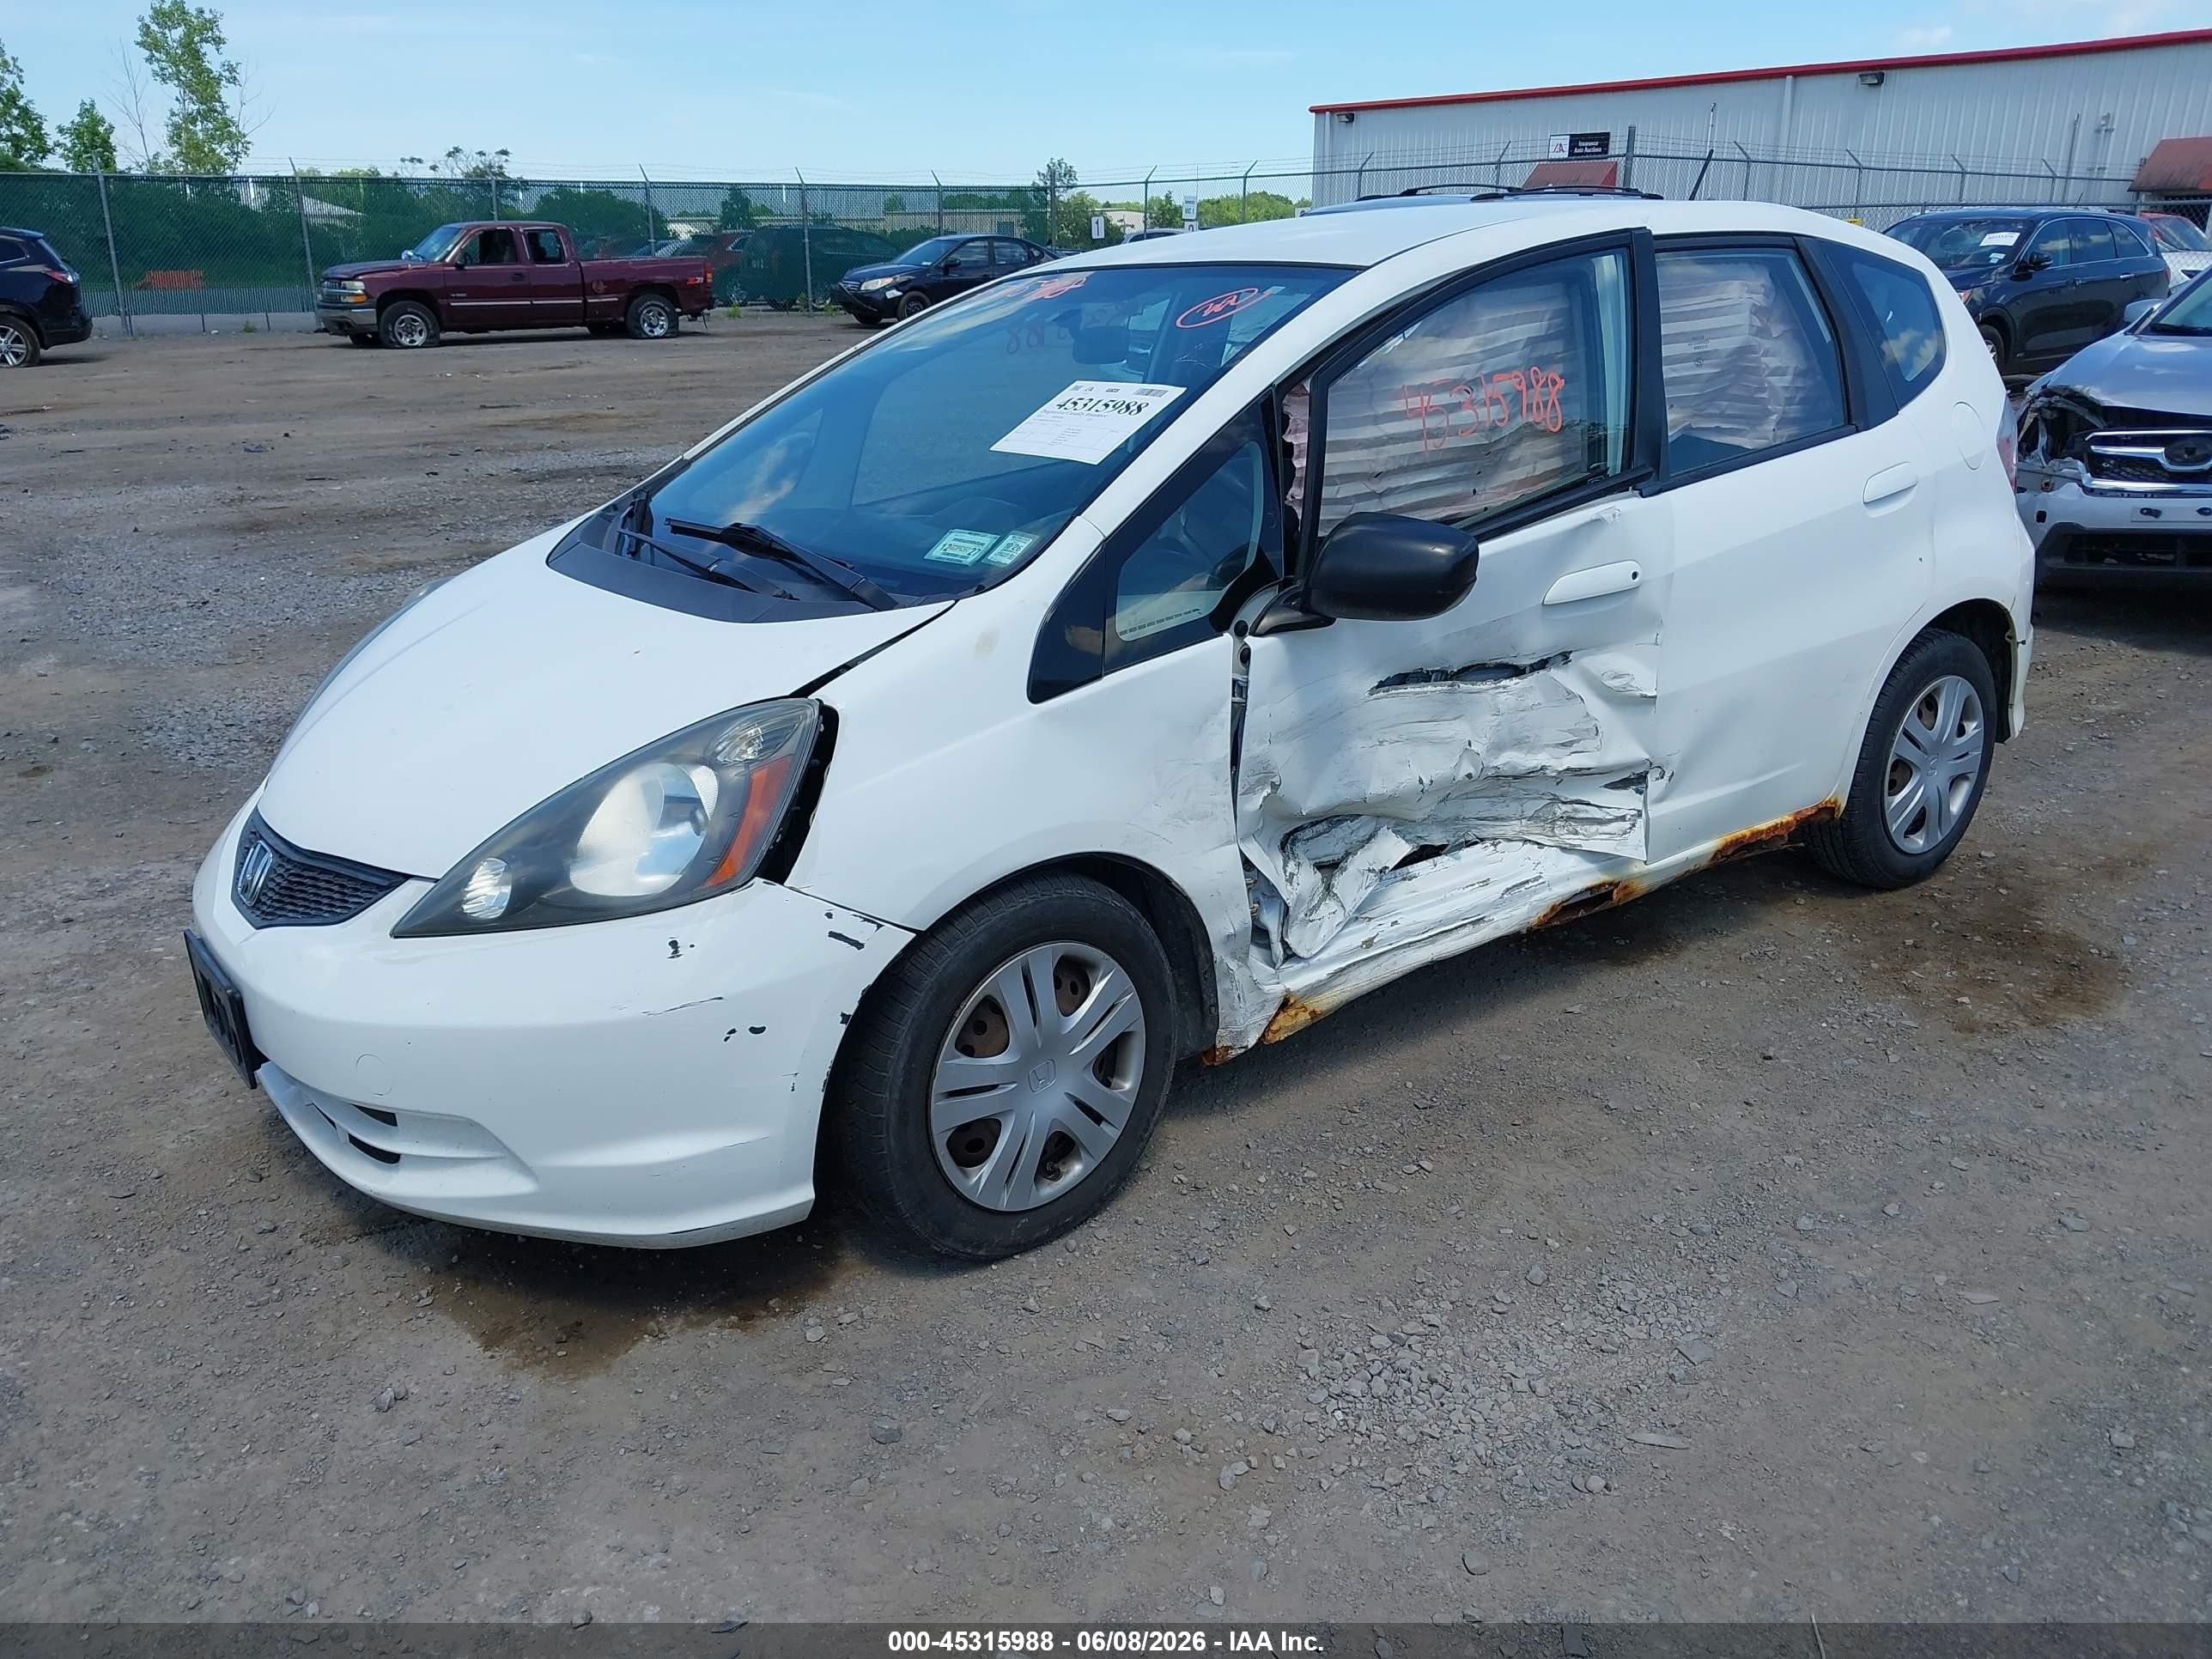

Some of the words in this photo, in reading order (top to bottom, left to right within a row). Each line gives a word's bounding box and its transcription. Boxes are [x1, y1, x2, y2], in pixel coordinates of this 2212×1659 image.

[1056, 398, 1149, 416] 45315988
[1401, 366, 1565, 452] 45315988
[939, 543, 952, 551] 12
[967, 547, 982, 557] 27
